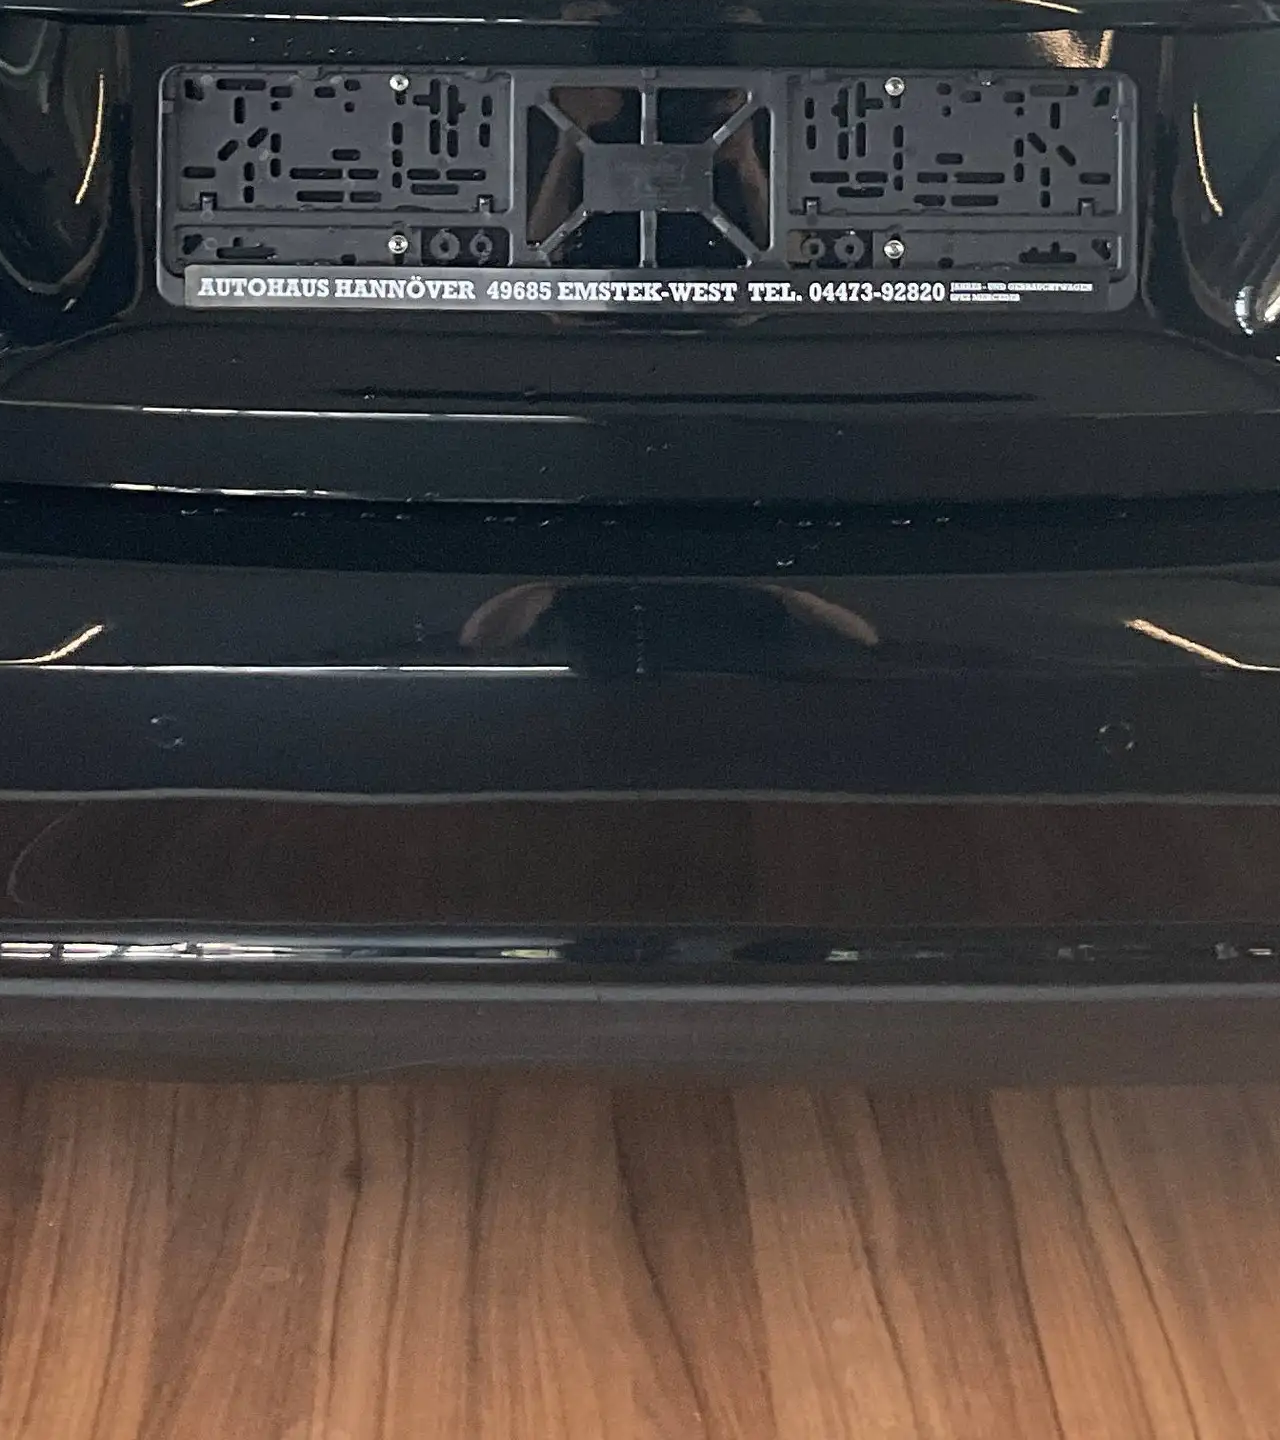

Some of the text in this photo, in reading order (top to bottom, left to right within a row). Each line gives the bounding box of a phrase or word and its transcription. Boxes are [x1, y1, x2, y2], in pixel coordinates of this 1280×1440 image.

[198, 275, 946, 302] AUTOHAUS HANNÖVER 49685 EMSTEK-WEST TEL. 04473-92820
